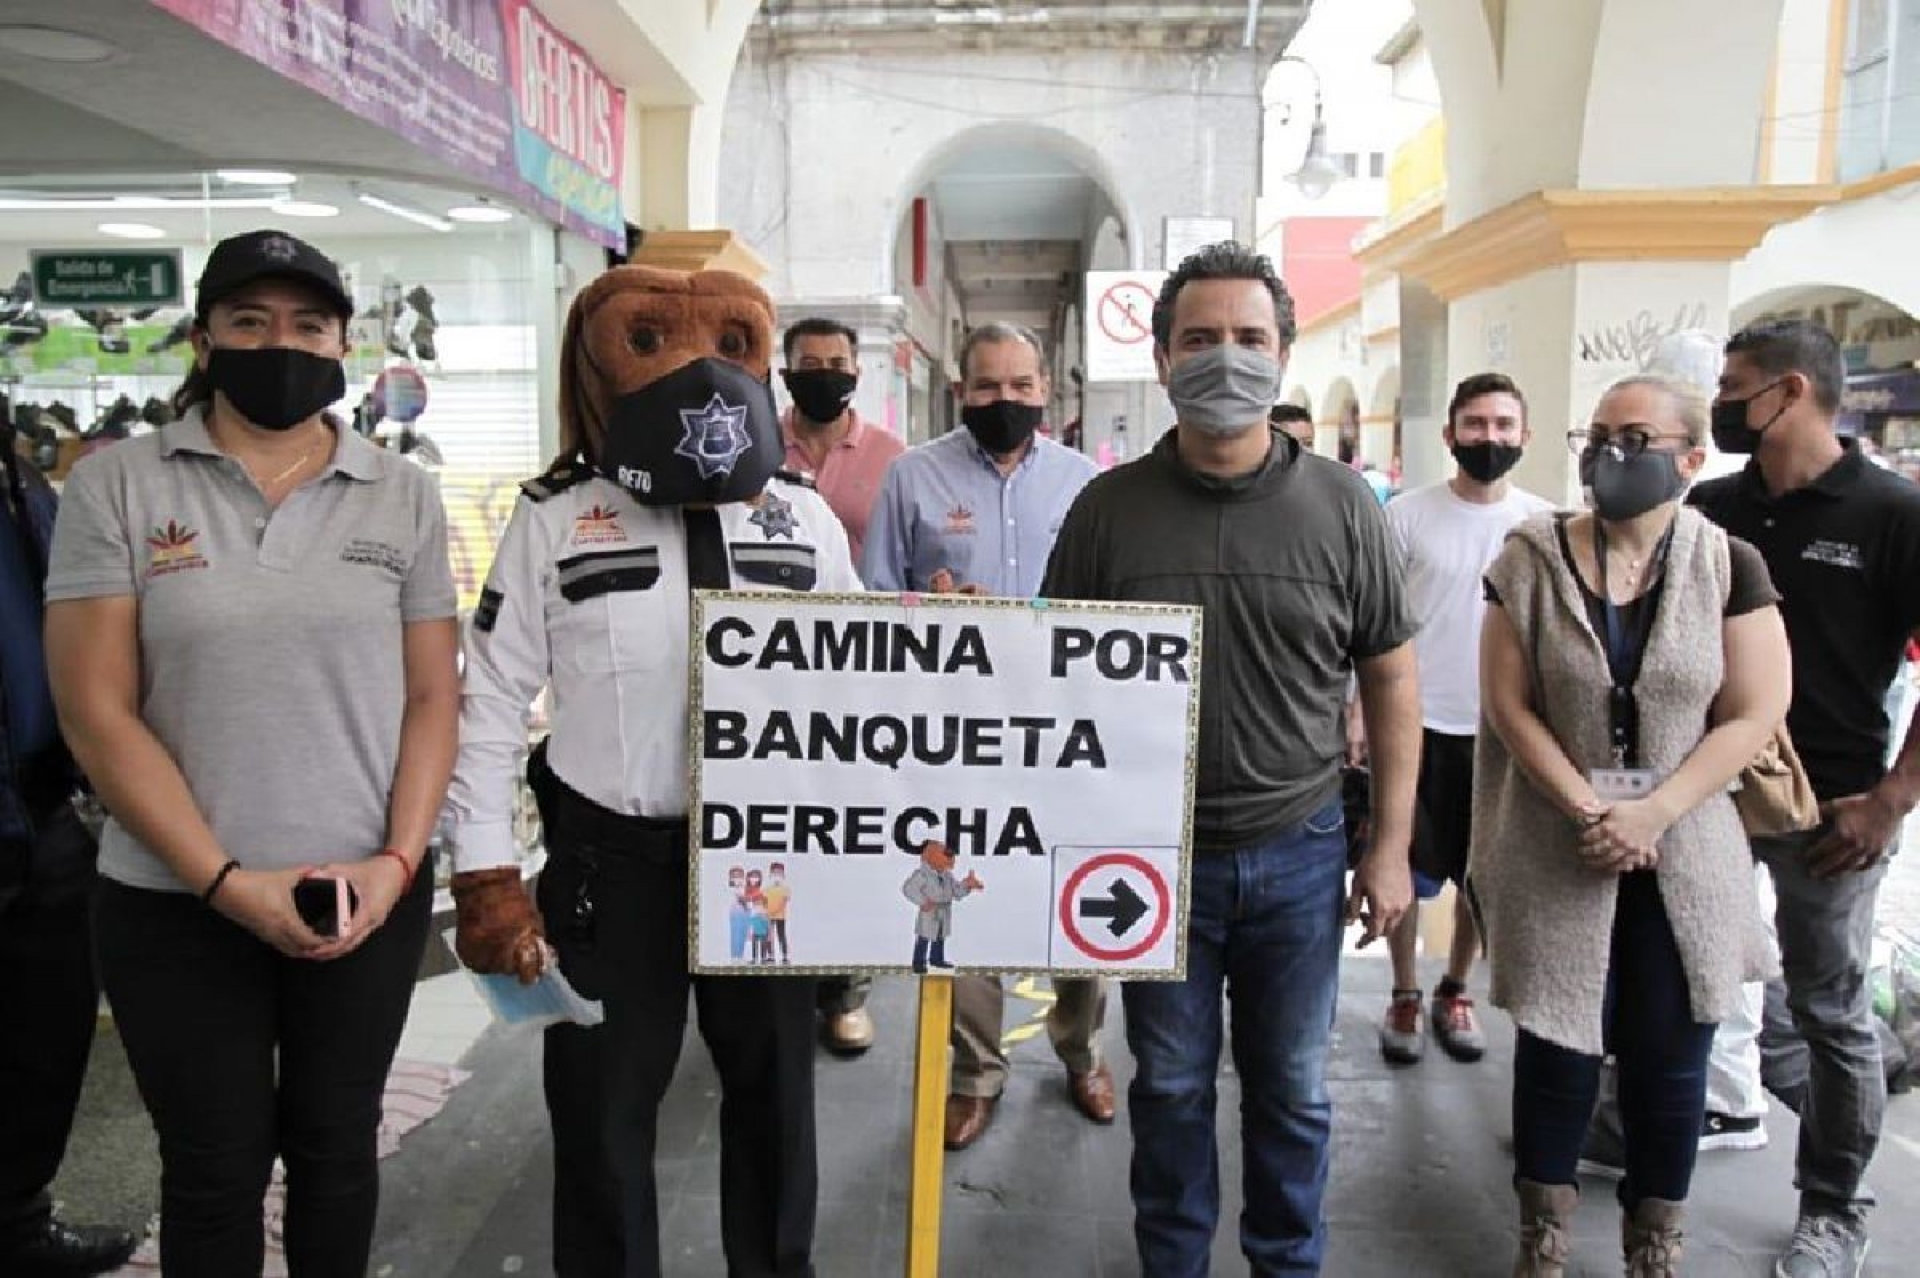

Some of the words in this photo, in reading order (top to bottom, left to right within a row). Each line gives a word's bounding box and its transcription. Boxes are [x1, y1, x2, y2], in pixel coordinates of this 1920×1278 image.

[705, 616, 993, 675] CAMINA
[1050, 627, 1189, 682] POR
[703, 709, 1107, 770] BANQUETA
[701, 802, 1045, 856] DERECHA
